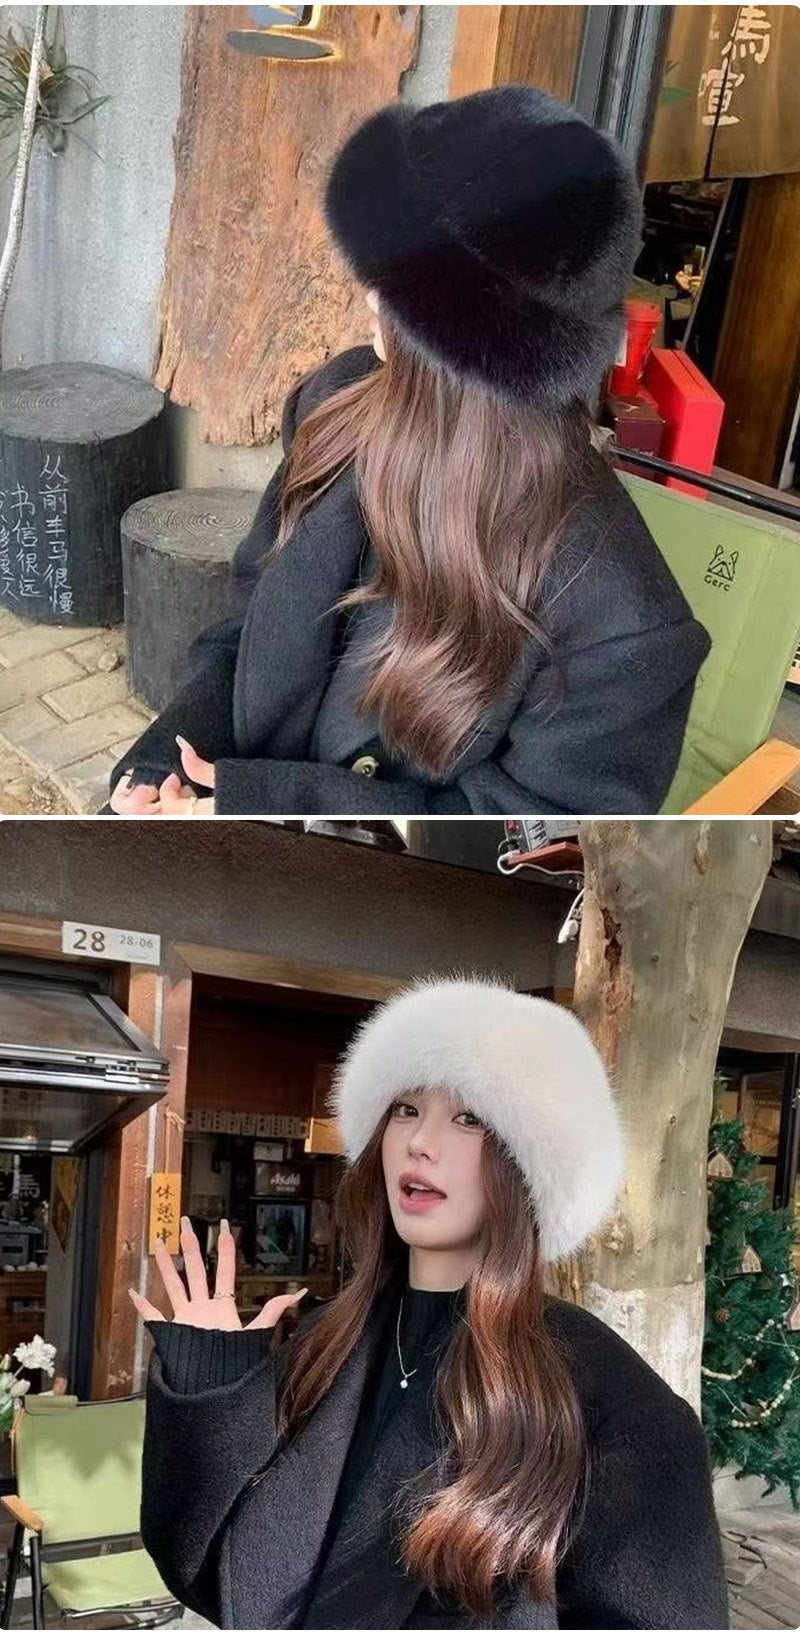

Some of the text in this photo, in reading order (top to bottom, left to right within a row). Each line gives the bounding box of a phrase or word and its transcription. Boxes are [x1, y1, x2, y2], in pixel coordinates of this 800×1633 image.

[11, 483, 43, 598] 书信很远
[73, 928, 106, 952] 28
